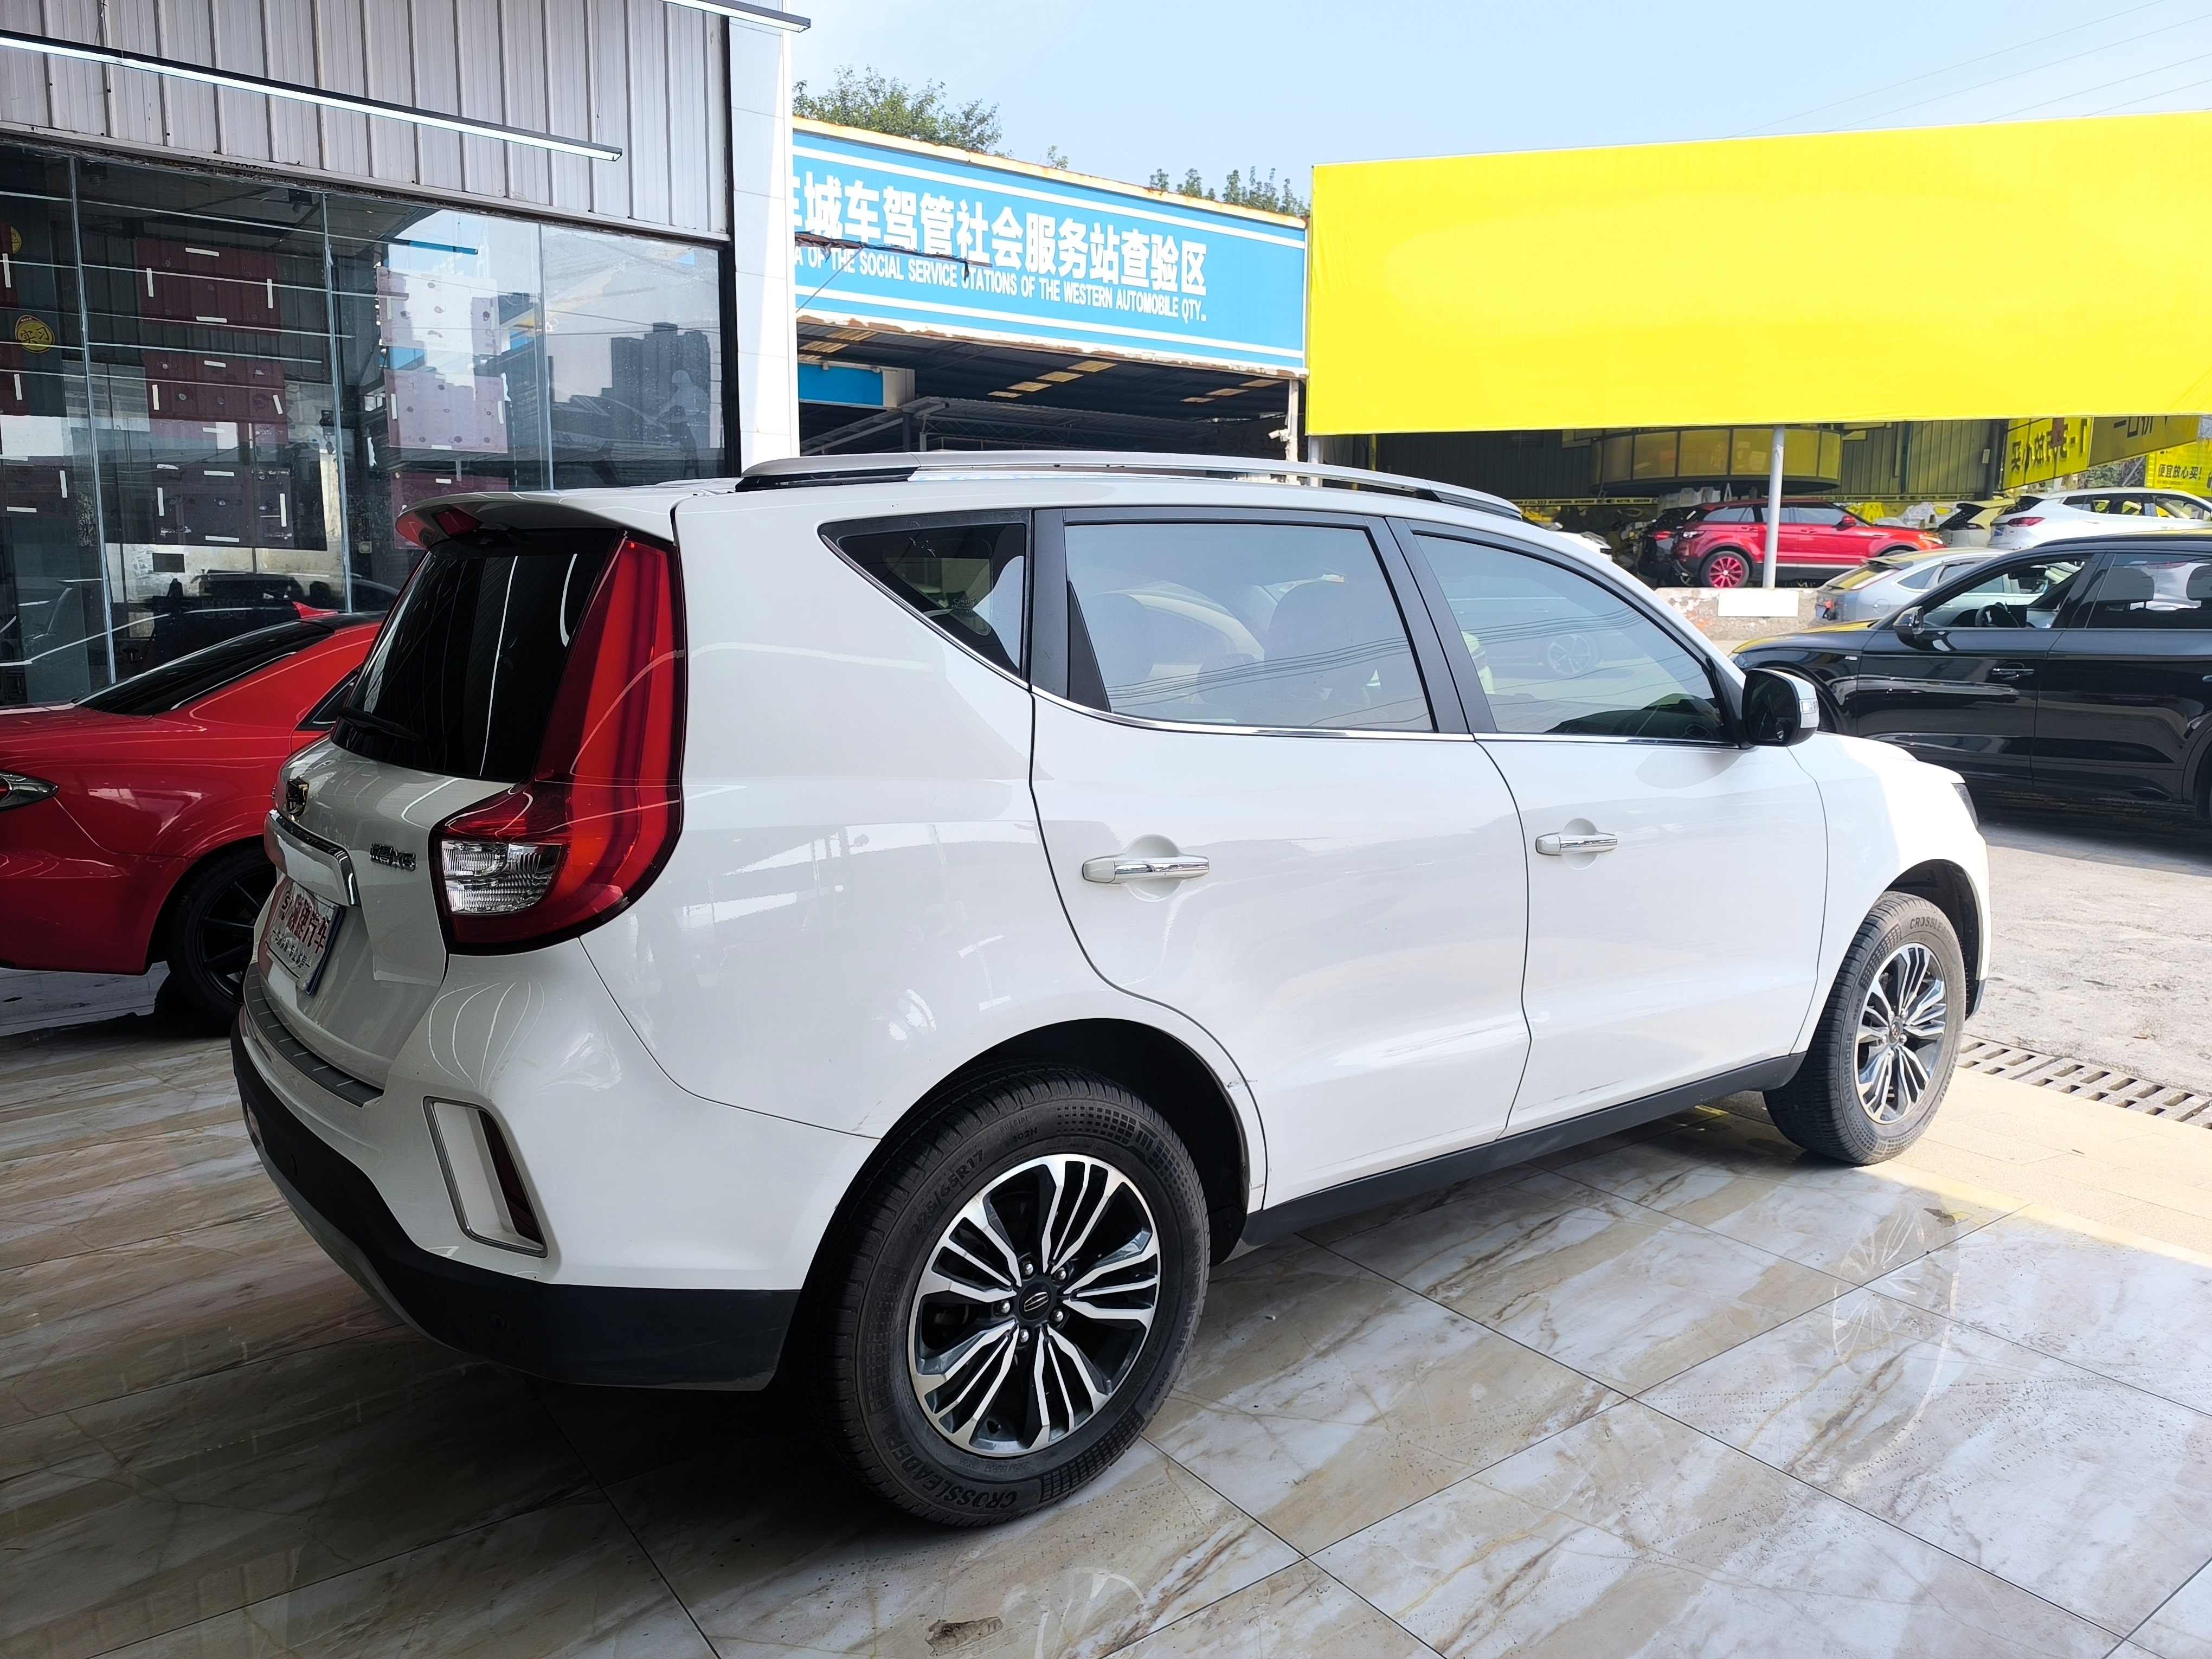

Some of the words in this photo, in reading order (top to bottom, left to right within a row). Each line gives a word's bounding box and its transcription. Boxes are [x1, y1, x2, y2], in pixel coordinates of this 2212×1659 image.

[807, 247, 825, 268] OF
[831, 247, 856, 273] THE
[859, 250, 904, 280] SOCIAL
[908, 258, 957, 288] SERVICE
[961, 266, 1018, 296] STATIONS
[1020, 274, 1035, 298] OF
[1039, 277, 1060, 302] THE
[1063, 280, 1113, 309] WESTERN
[1115, 288, 1179, 318] AUTOMOBILE
[21, 326, 50, 345] 实习
[1909, 916, 1956, 947] CROSSLEADER
[1843, 1032, 1854, 1111] LANDRIDER
[909, 1148, 983, 1239] 225/65R17
[1012, 1127, 1038, 1142] 102H
[885, 1433, 1018, 1509] CROSSLEADER
